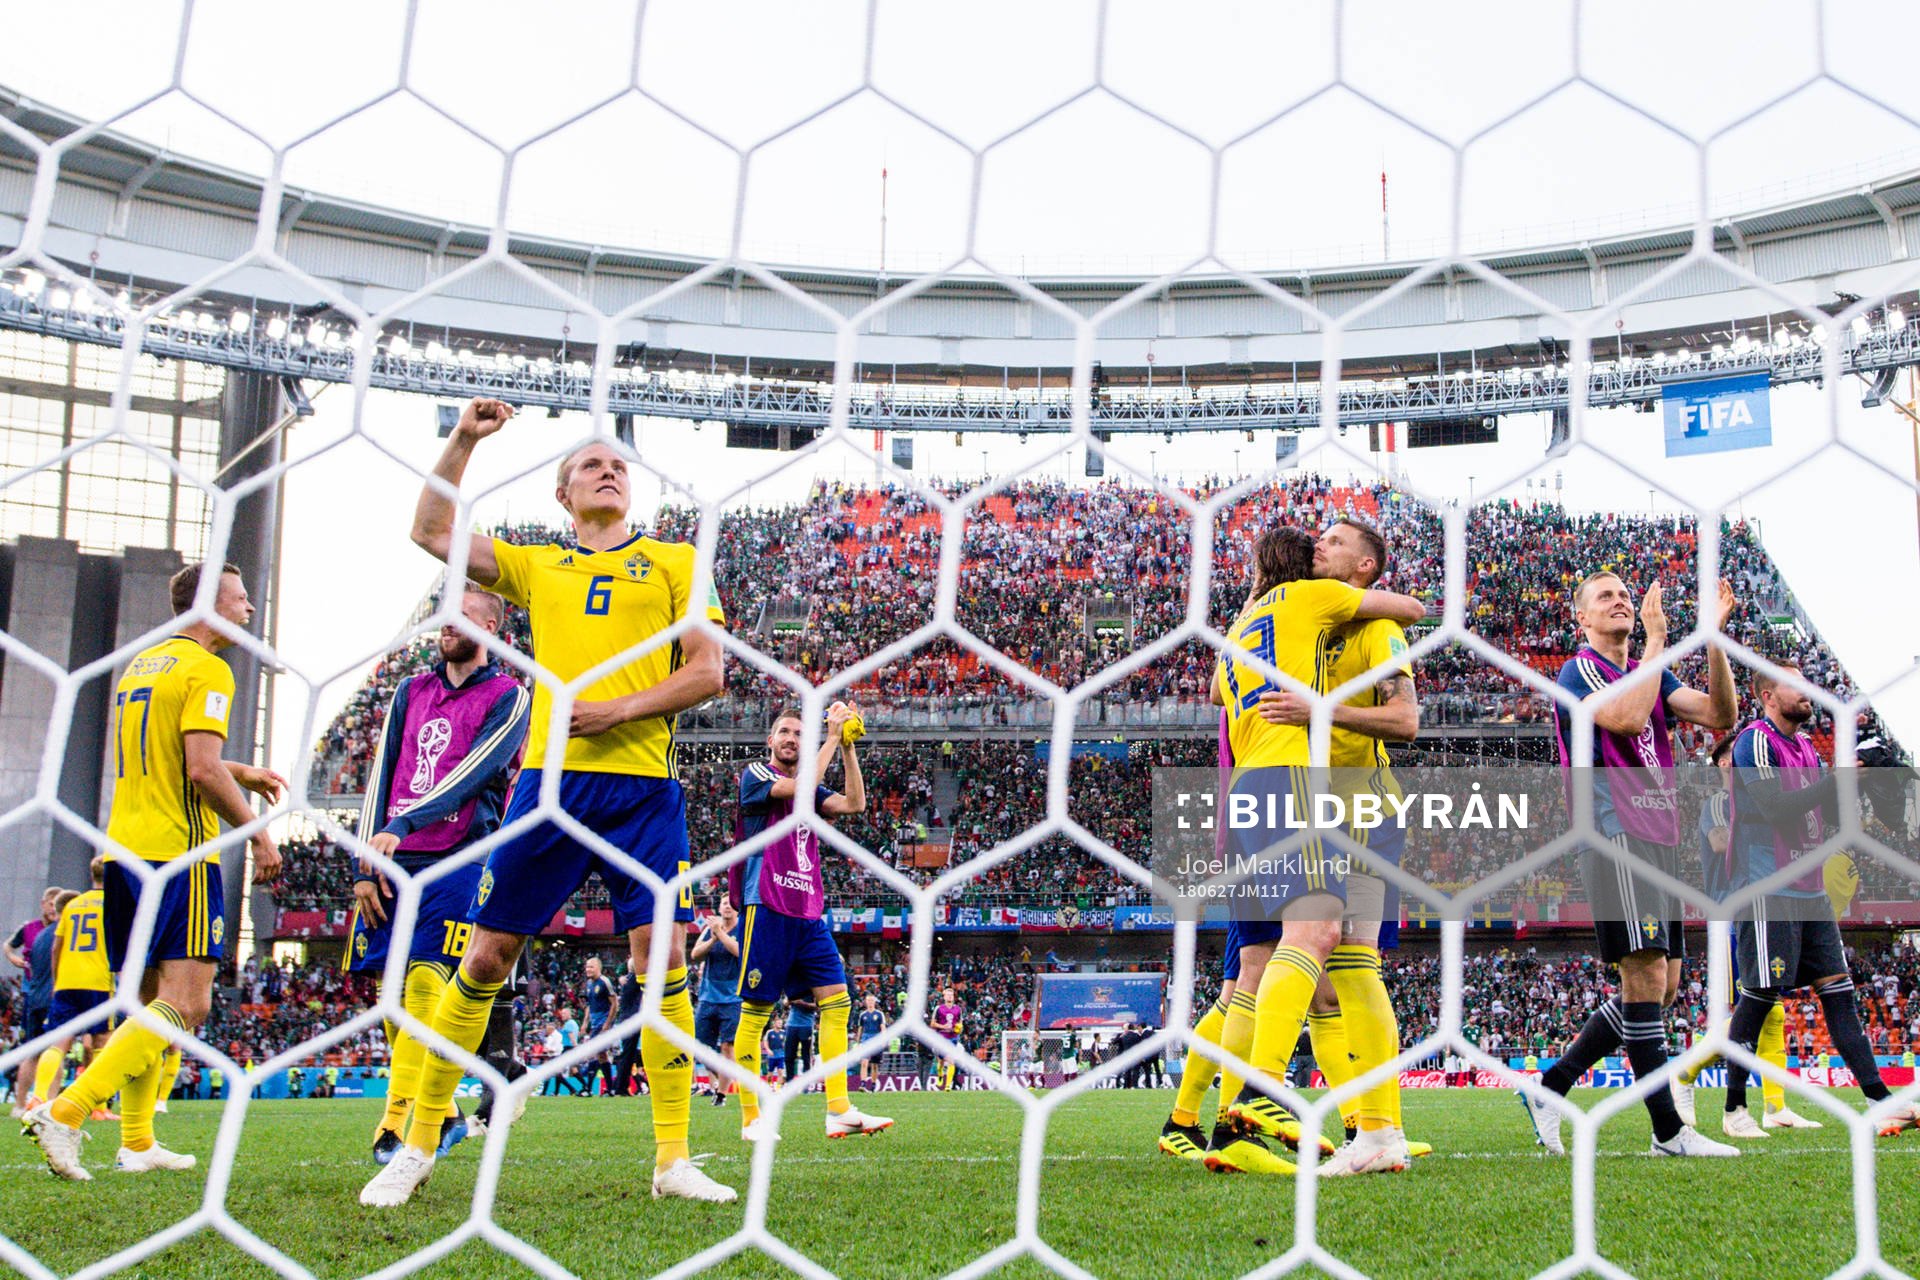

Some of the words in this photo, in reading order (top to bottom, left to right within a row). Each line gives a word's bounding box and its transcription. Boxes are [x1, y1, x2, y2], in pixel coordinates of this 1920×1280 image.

[1680, 400, 1753, 432] FIFA
[585, 575, 614, 615] 6
[1220, 613, 1281, 720] 13
[117, 687, 153, 778] 17
[69, 912, 98, 952] 15
[1131, 911, 1175, 925] RUSSI
[442, 920, 472, 957] 18
